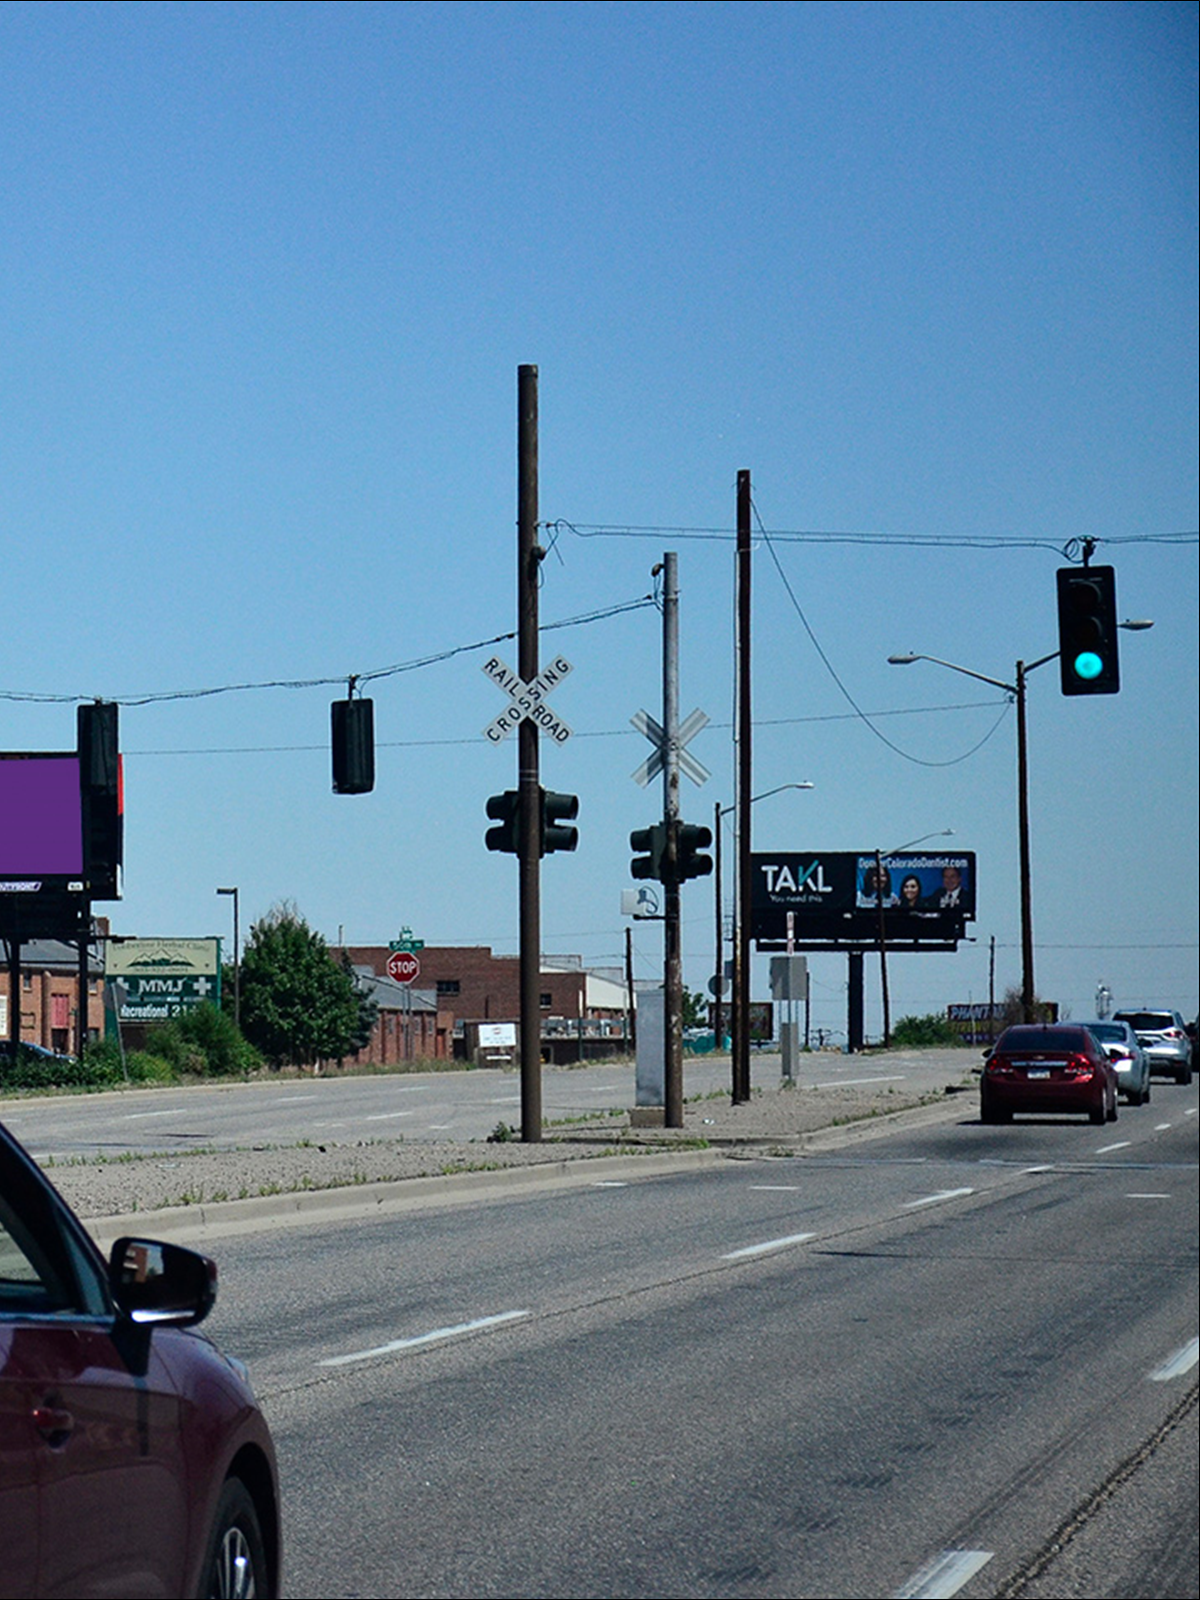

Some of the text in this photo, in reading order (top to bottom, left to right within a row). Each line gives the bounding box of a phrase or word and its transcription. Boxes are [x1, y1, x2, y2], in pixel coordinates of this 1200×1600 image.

[484, 658, 520, 697] RAIL
[486, 659, 569, 742] CROSSING
[532, 704, 569, 742] ROAD
[761, 859, 833, 893] TAKL
[769, 894, 823, 903] You need this
[390, 961, 417, 975] STOP
[138, 977, 187, 995] MMJ
